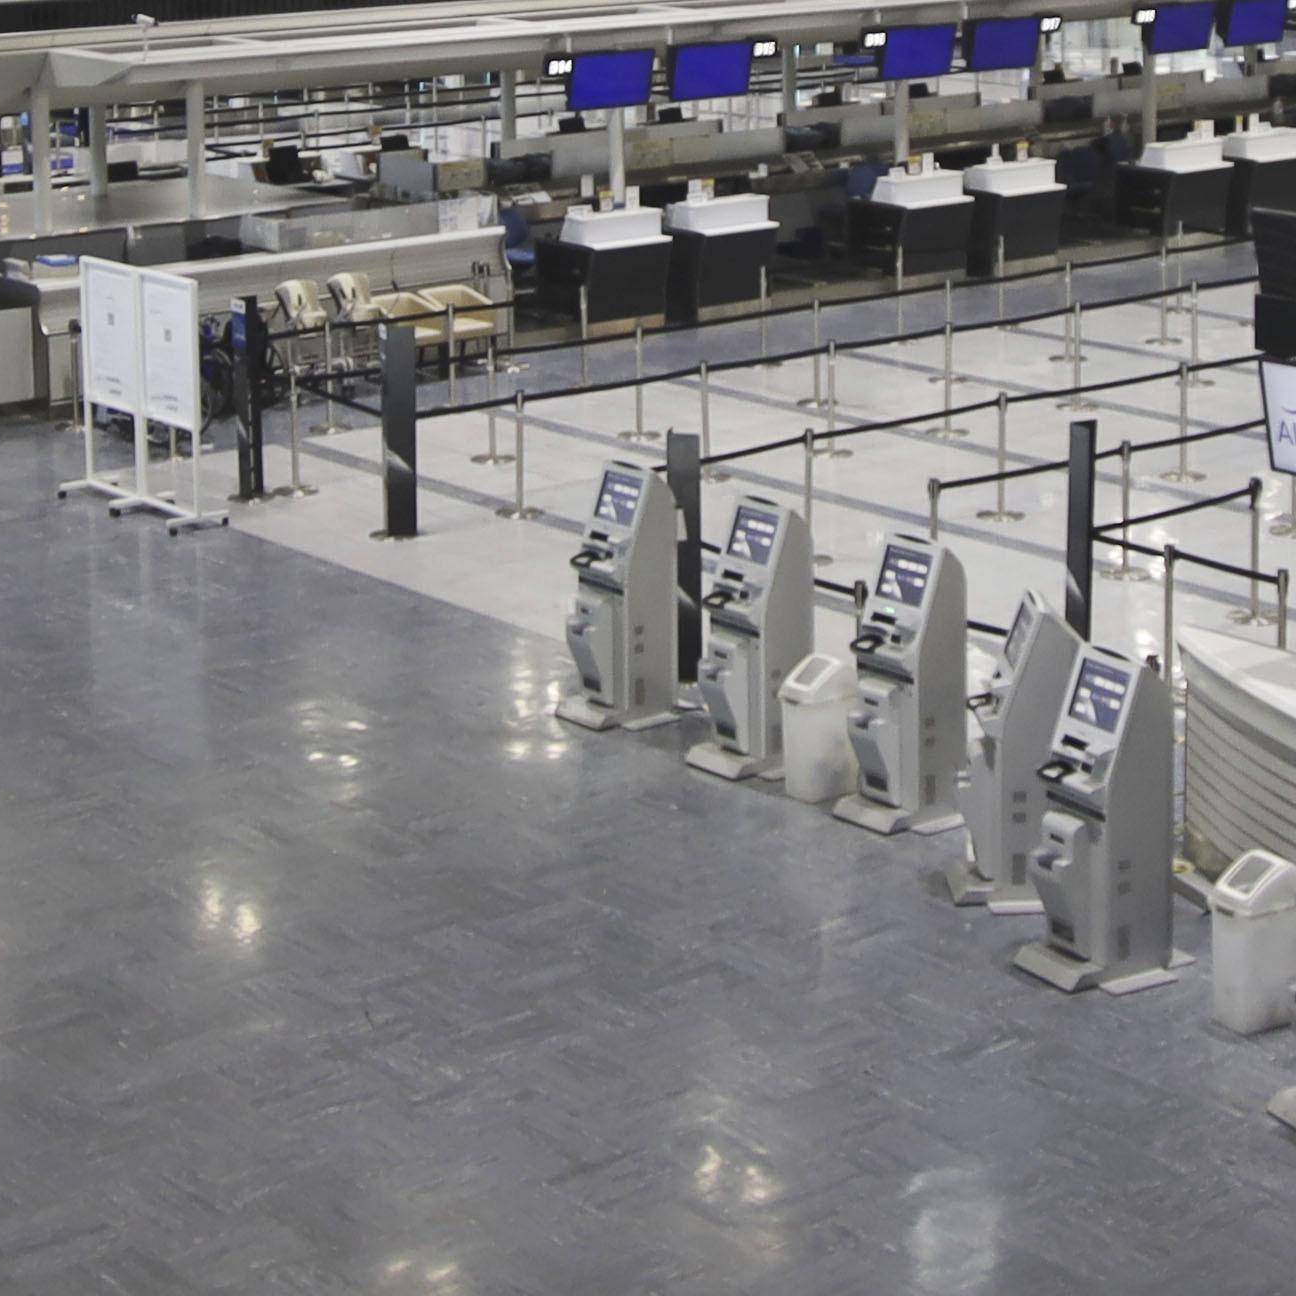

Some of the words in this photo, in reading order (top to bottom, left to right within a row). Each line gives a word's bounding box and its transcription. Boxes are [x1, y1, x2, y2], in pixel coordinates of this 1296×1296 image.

[1041, 17, 1061, 31] B17
[753, 42, 775, 56] B15
[548, 59, 572, 75] B14
